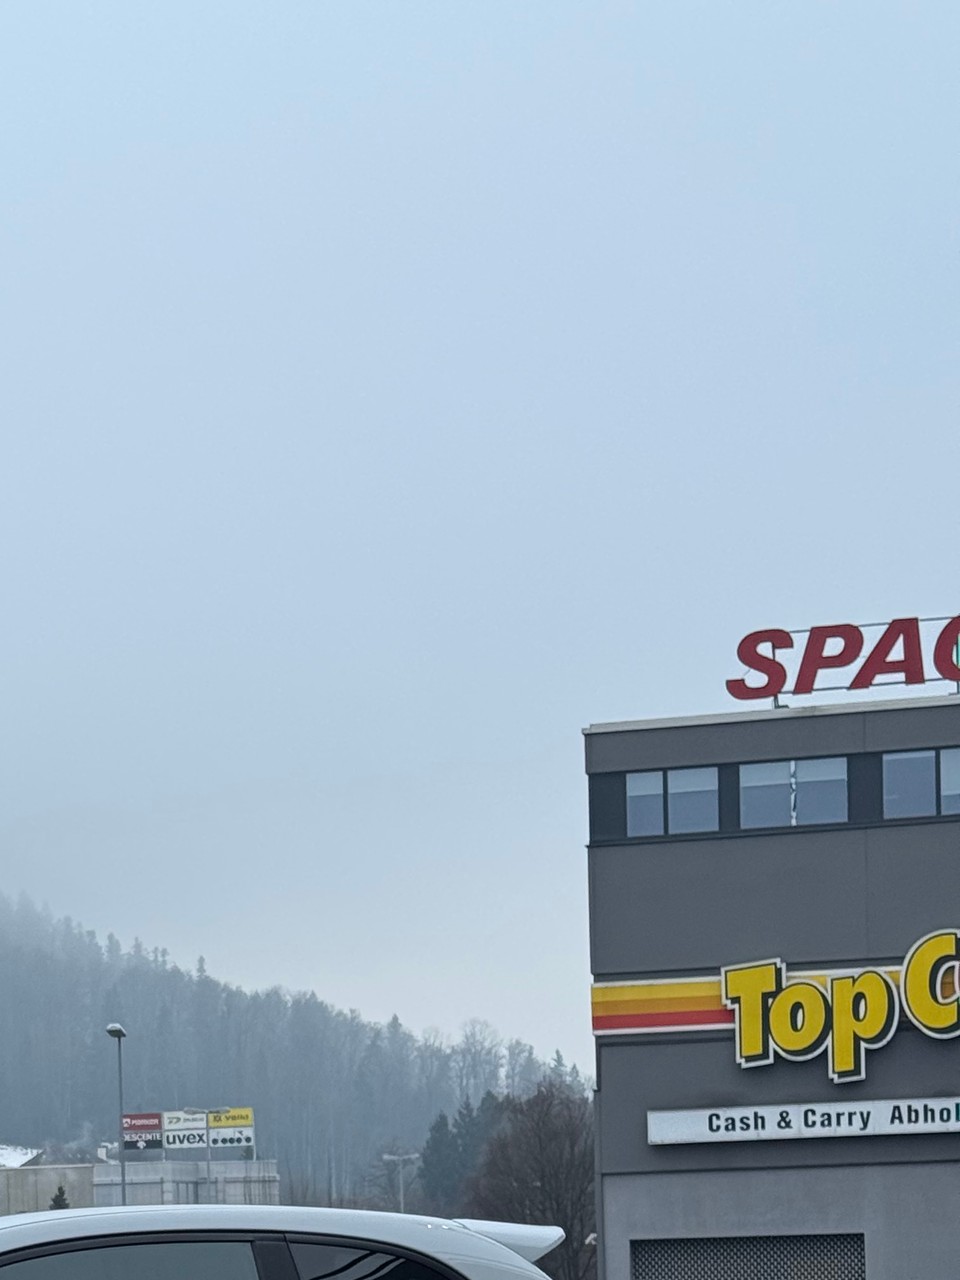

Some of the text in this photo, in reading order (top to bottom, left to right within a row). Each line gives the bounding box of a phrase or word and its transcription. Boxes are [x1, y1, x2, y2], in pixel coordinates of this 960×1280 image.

[707, 1111, 766, 1133] Cash
[777, 1110, 793, 1130] &
[803, 1108, 871, 1131] Carry
[166, 1132, 207, 1146] uvex
